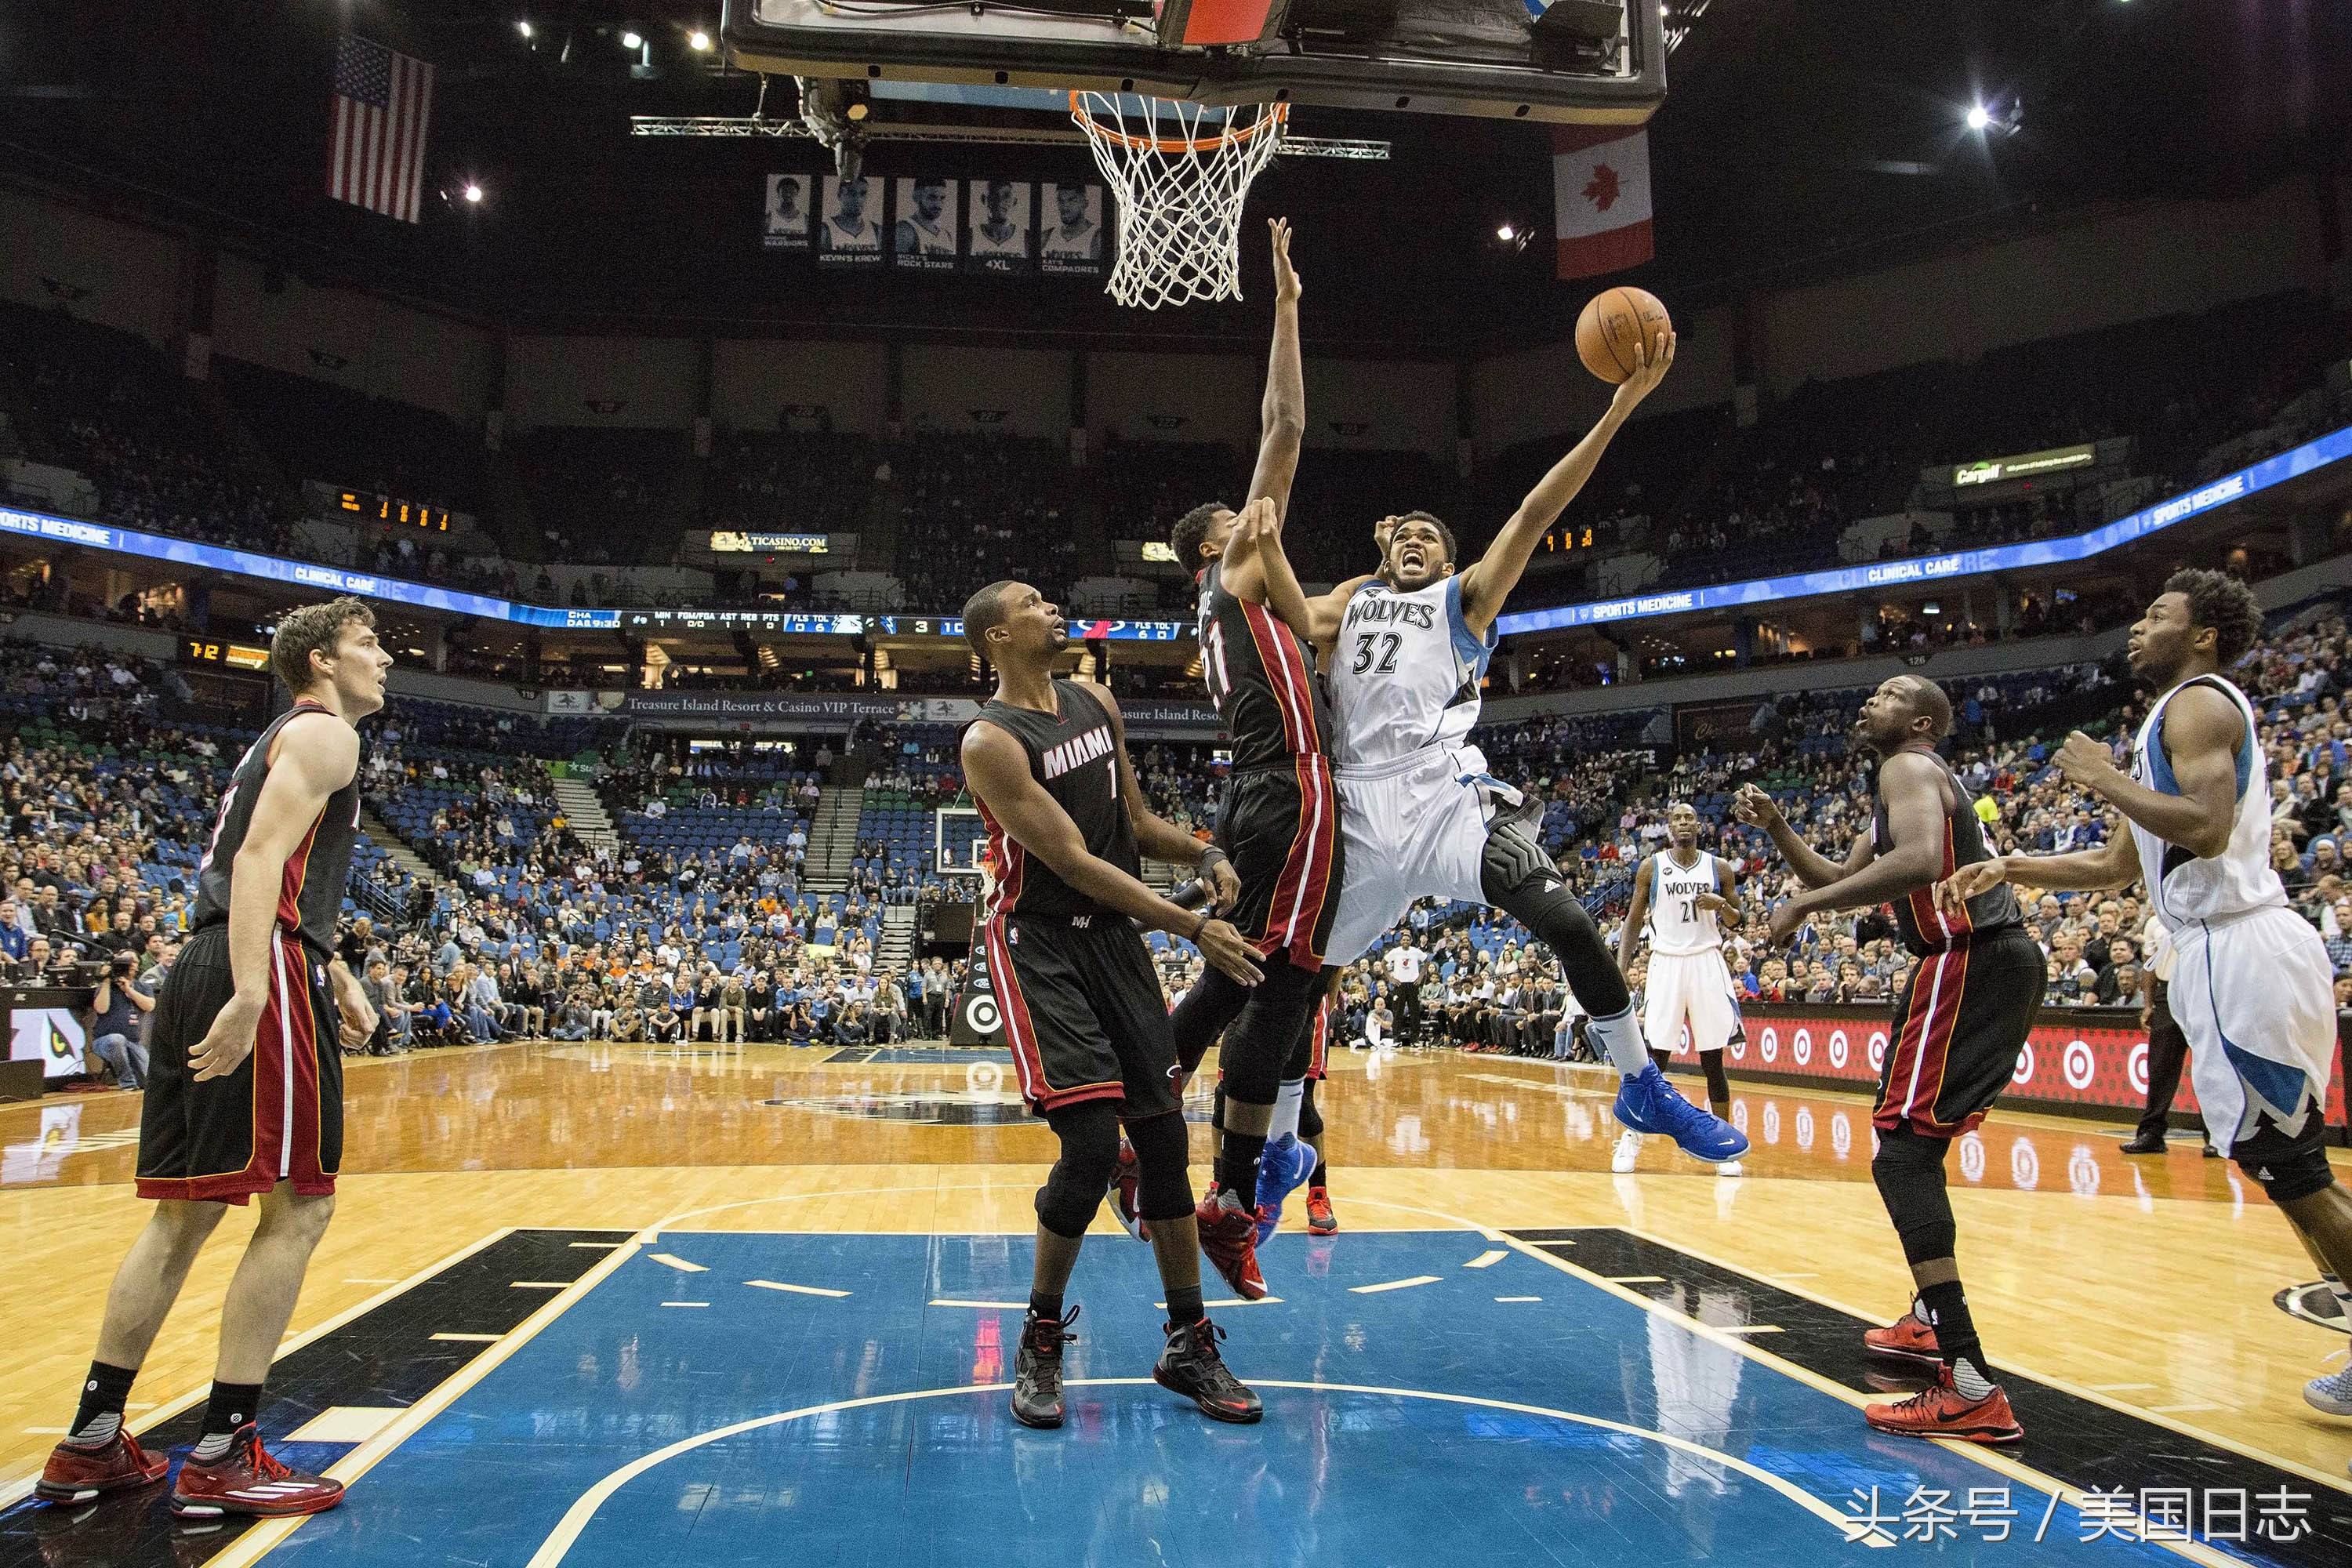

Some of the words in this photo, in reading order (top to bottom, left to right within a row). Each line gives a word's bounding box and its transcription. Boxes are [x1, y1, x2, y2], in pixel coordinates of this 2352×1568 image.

[985, 260, 1011, 270] 4XL
[1956, 463, 2002, 485] Cargill
[0, 511, 39, 532] ORTS
[41, 519, 111, 545] MEDICINE
[751, 536, 826, 547] TICASINO.COM
[294, 567, 344, 587] CLINICAL
[346, 576, 376, 592] CARE
[1868, 564, 1923, 583] CLINICAL
[1925, 558, 1959, 575] CARE
[677, 612, 716, 621] FGM/FGA
[740, 613, 758, 622] REB
[762, 613, 779, 622] PTS
[1345, 598, 1436, 631] WOLVES
[1592, 601, 1636, 619] SPORTS
[1637, 593, 1693, 614] MEDICINE
[815, 623, 825, 633] 6
[915, 620, 928, 633] 3
[1134, 621, 1152, 630] FLS
[1154, 622, 1171, 630] TOL
[1138, 630, 1148, 639] 6
[1352, 632, 1403, 674] 32
[628, 698, 680, 711] Treasure
[682, 699, 718, 712] Island
[722, 700, 760, 712] Resort
[763, 701, 775, 713] &
[778, 701, 820, 713] Casino
[822, 702, 847, 713] VIP
[850, 702, 895, 714] Terrace
[1121, 710, 1152, 720] asure
[1154, 708, 1189, 720] Island
[1192, 709, 1222, 720] Reso
[1042, 724, 1114, 780] MIAMI
[1107, 757, 1117, 800] 1
[1680, 898, 1699, 924] 21
